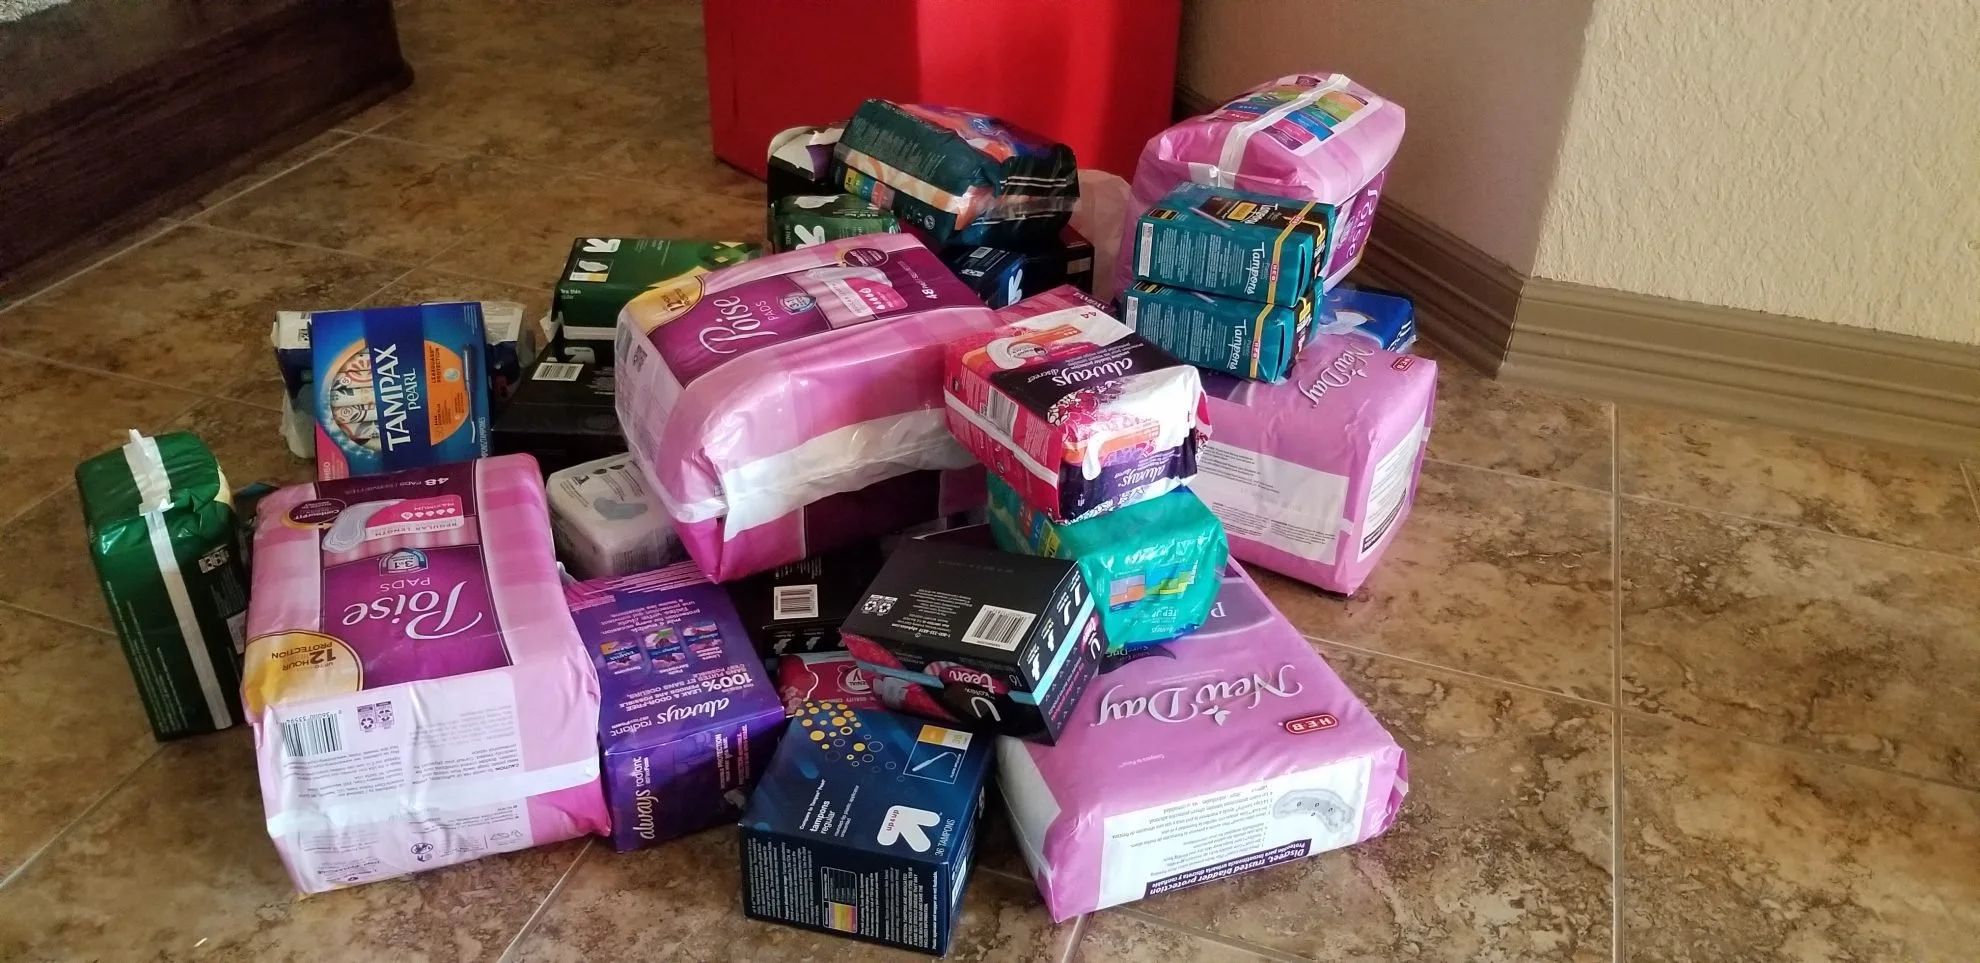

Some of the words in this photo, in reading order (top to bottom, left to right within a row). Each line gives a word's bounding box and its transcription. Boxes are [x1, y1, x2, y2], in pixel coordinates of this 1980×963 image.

[1242, 240, 1266, 296] Tampons
[756, 300, 780, 321] PADS
[699, 296, 778, 355] Poise
[1224, 318, 1247, 371] Tampons
[1053, 358, 1133, 387] always
[1299, 365, 1352, 407] Day
[374, 344, 411, 452] TAMPAX
[423, 475, 449, 485] 48
[1119, 464, 1165, 487] always
[373, 527, 410, 537] LENGTH
[414, 520, 456, 531] REGULAR
[380, 577, 430, 592] PADS
[343, 580, 482, 640] Poise
[270, 641, 333, 658] PROTECTION
[308, 647, 336, 664] 12
[281, 659, 309, 670] HOUR
[701, 670, 752, 693] 100%
[947, 670, 996, 692] teen
[1195, 664, 1303, 710] New
[657, 697, 730, 725] always
[1098, 684, 1199, 727] Day
[610, 721, 653, 737] radiant
[632, 788, 660, 840] always
[798, 810, 811, 830] Compare
[809, 798, 831, 833] tampons
[819, 809, 837, 835] regular
[937, 817, 956, 848] TAMPONS
[934, 846, 945, 857] 36
[1266, 847, 1305, 863] Discreet,
[1182, 869, 1205, 879] discreta
[1196, 866, 1233, 882] bladder
[1232, 858, 1266, 872] trusted
[1148, 875, 1198, 895] protection
